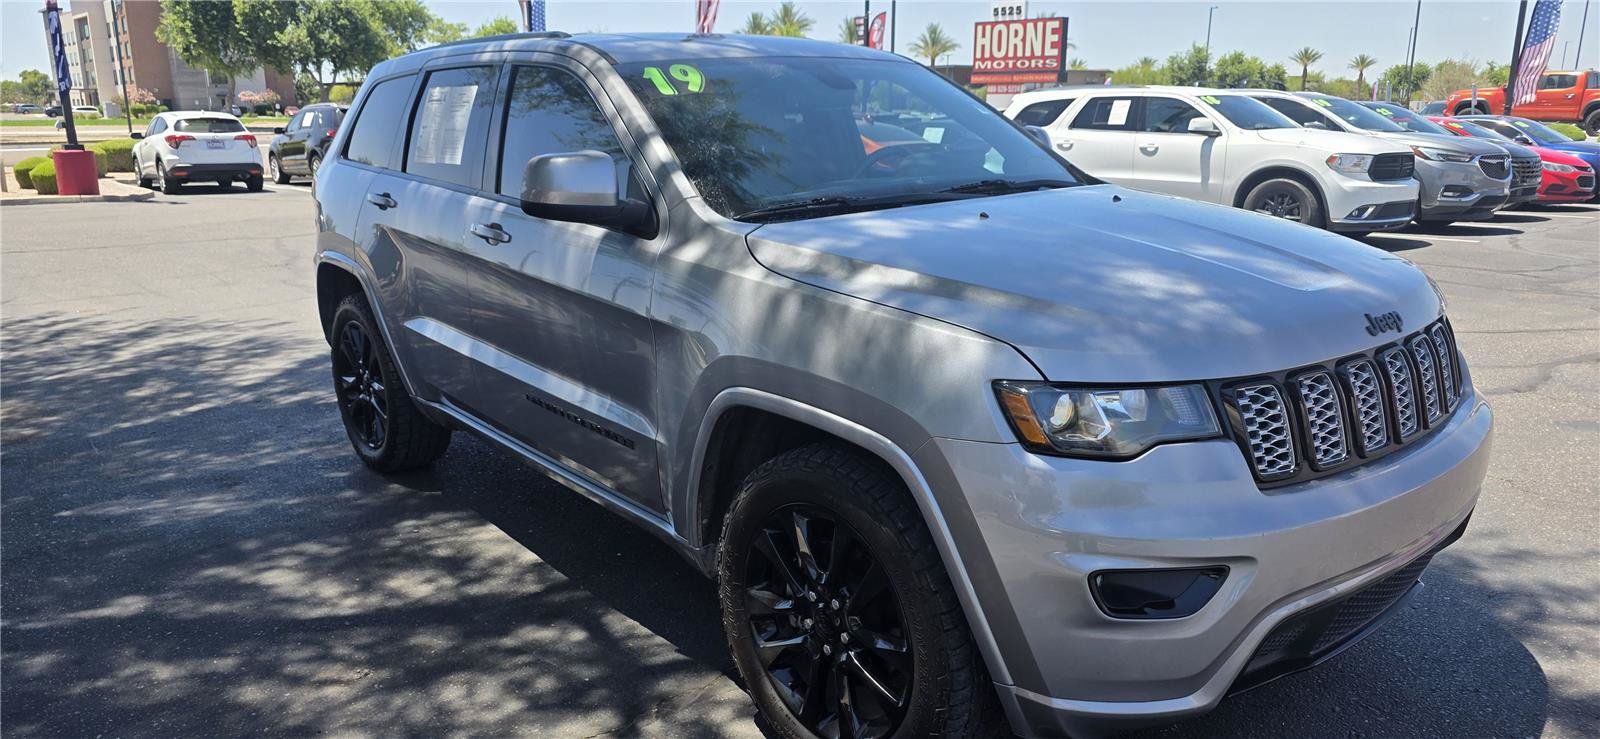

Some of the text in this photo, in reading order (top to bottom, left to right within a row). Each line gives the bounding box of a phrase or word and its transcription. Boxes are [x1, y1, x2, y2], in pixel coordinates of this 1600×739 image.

[993, 5, 1022, 16] 5525
[975, 20, 1060, 59] HORNE
[974, 58, 1058, 70] MOTORS
[643, 64, 705, 95] 19
[1364, 311, 1403, 336] Jeep
